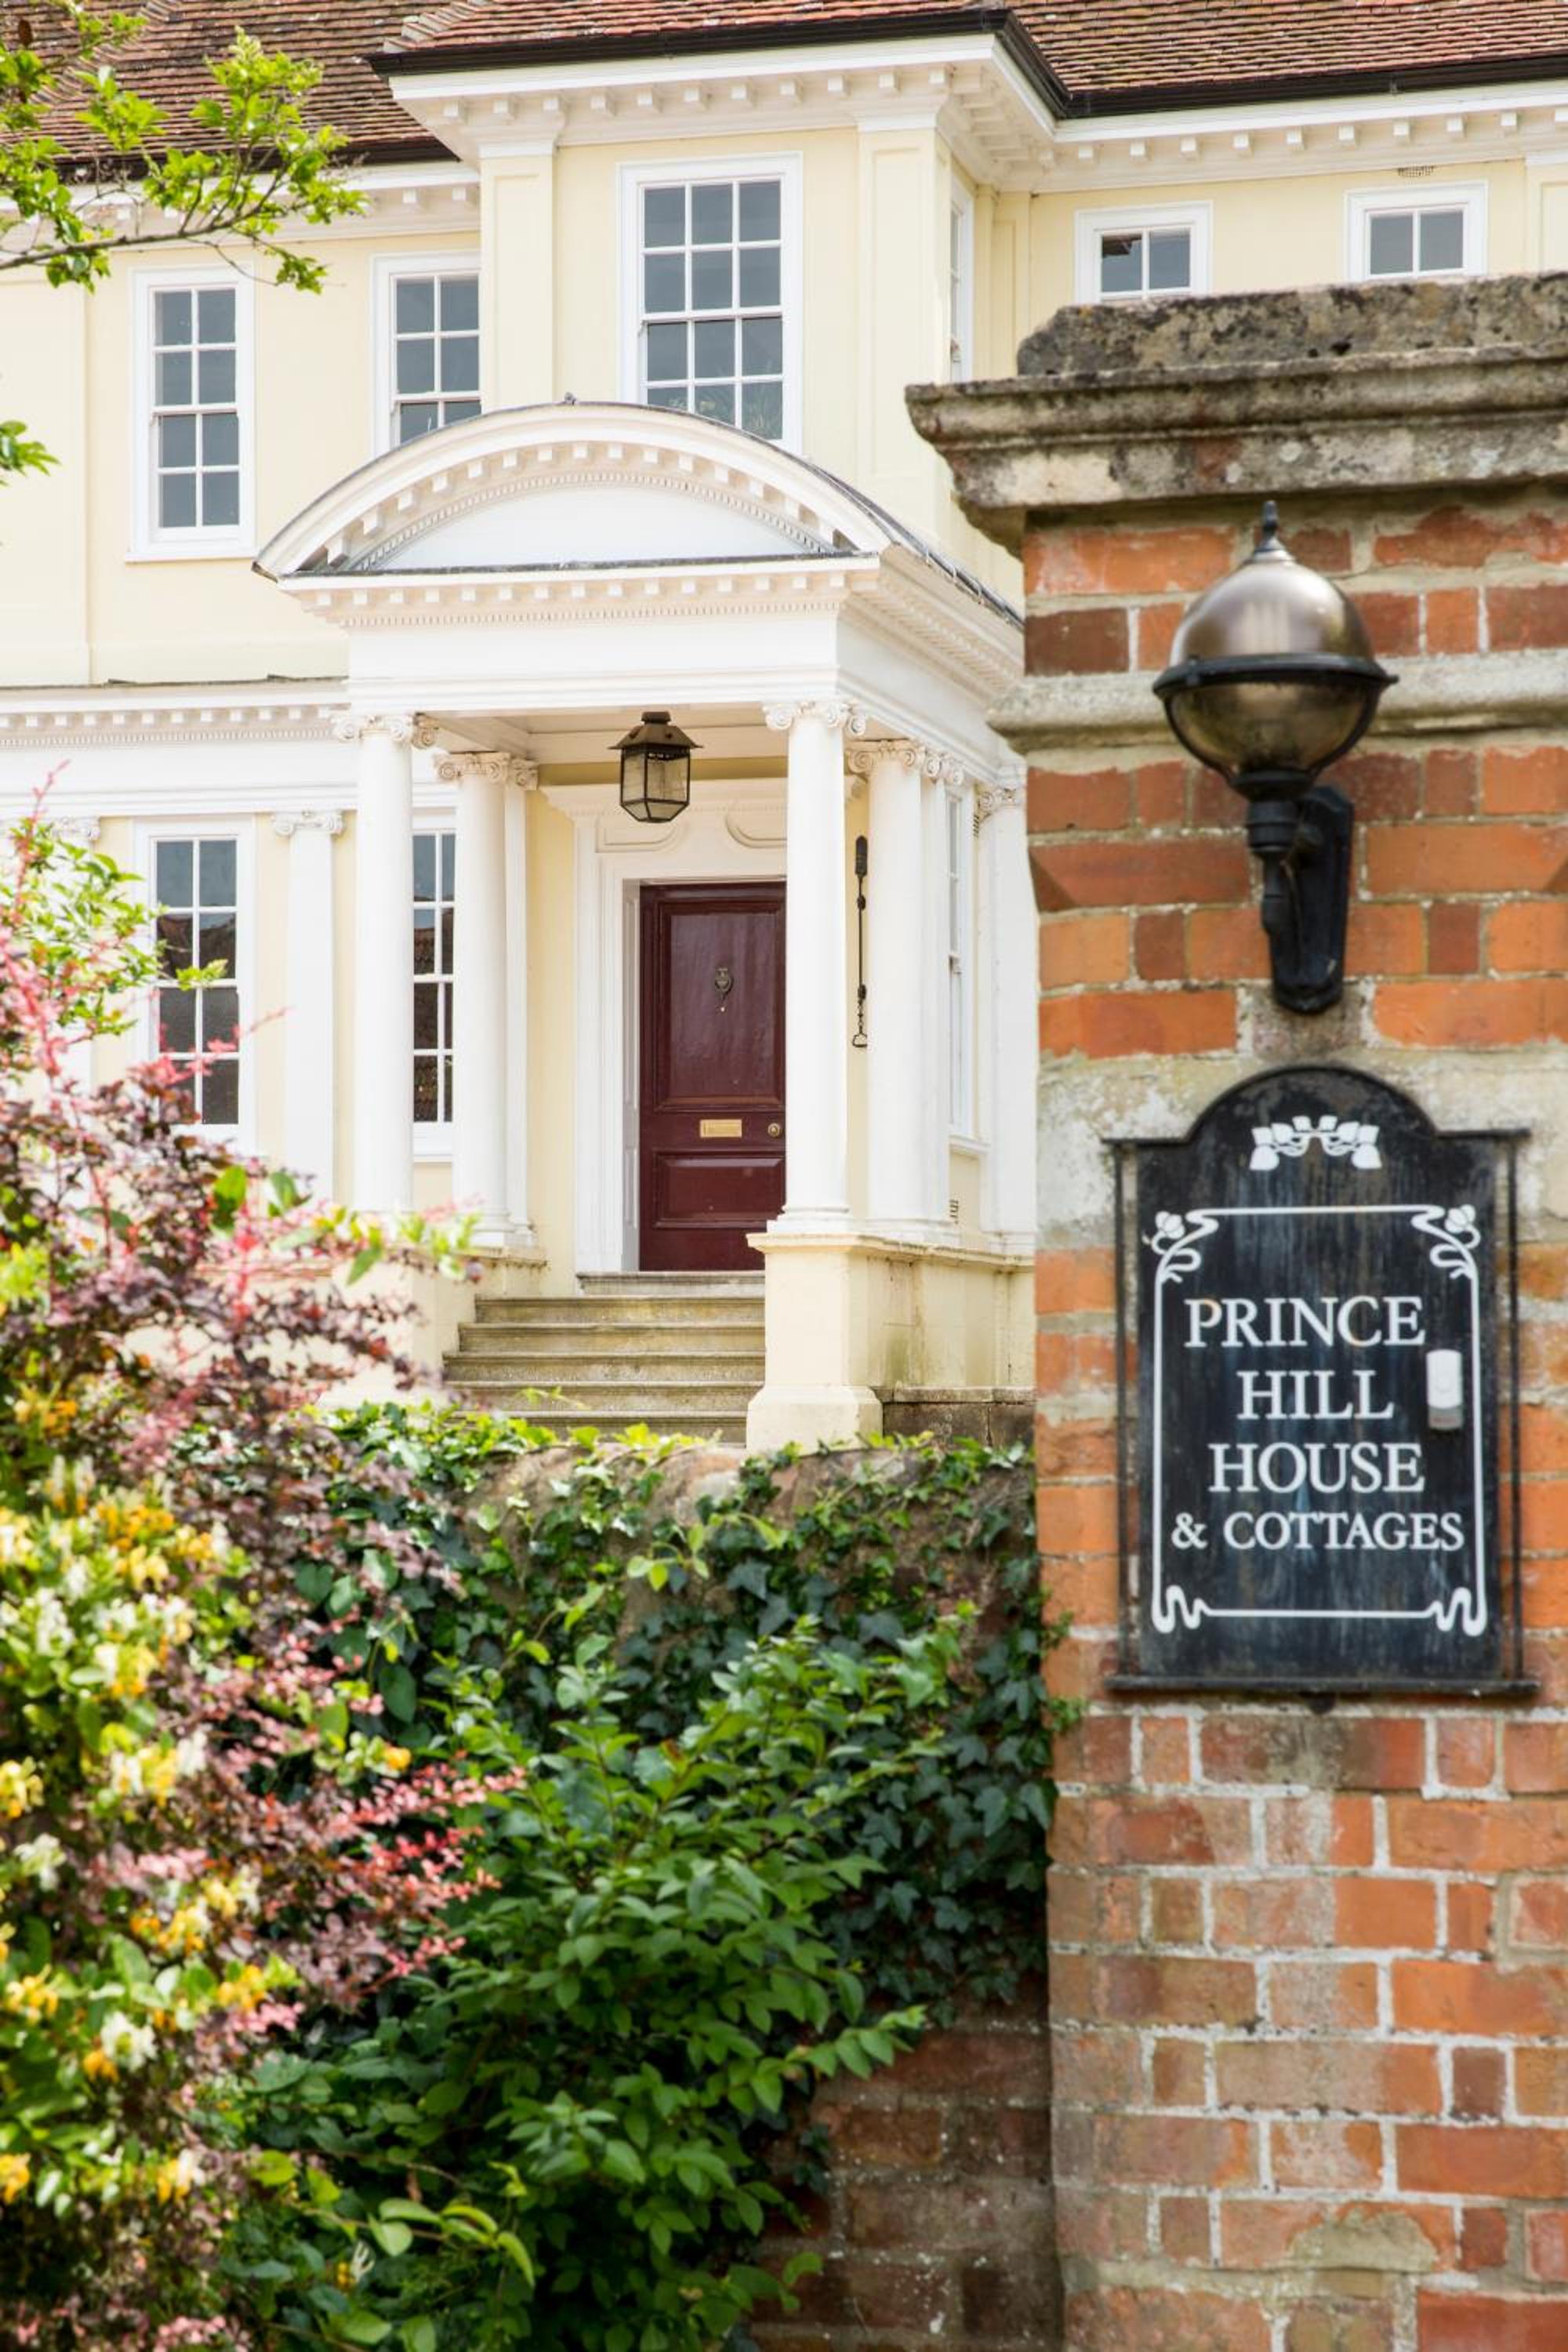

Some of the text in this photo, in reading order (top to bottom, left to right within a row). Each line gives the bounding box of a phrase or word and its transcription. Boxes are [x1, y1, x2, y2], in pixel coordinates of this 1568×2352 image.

[1185, 1295, 1426, 1348] PRINCE
[1236, 1370, 1395, 1421] HILL
[1208, 1441, 1425, 1494] HOUSE
[1171, 1511, 1465, 1552] & COTTAGES
